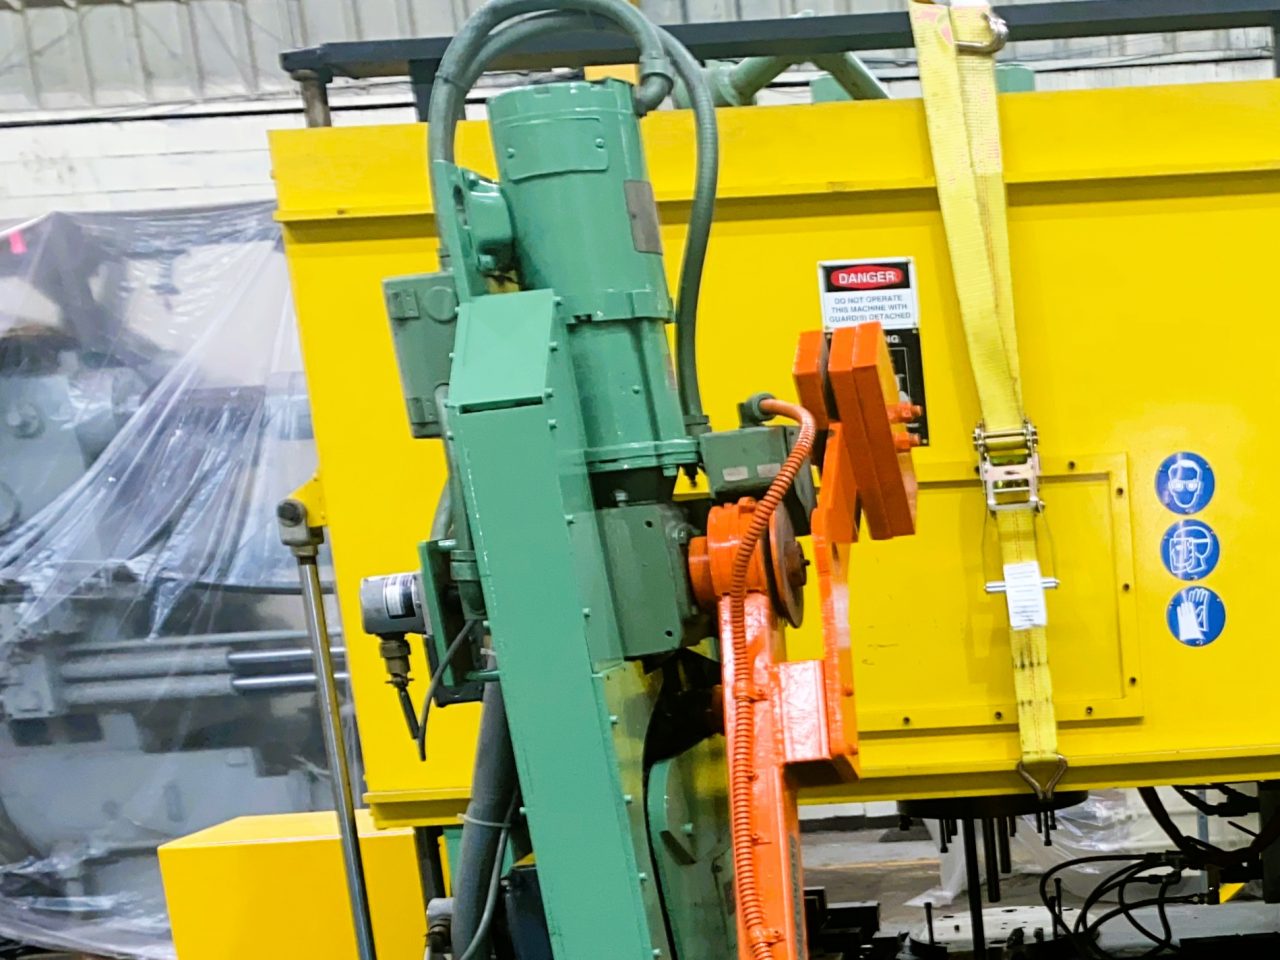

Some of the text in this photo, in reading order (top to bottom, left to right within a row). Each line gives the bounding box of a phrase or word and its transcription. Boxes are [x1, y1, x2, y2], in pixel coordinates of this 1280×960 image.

[838, 271, 895, 284] DANGER
[834, 295, 902, 305] DO NOT OPERATE
[829, 312, 910, 323] GUARD(S) DETACHED
